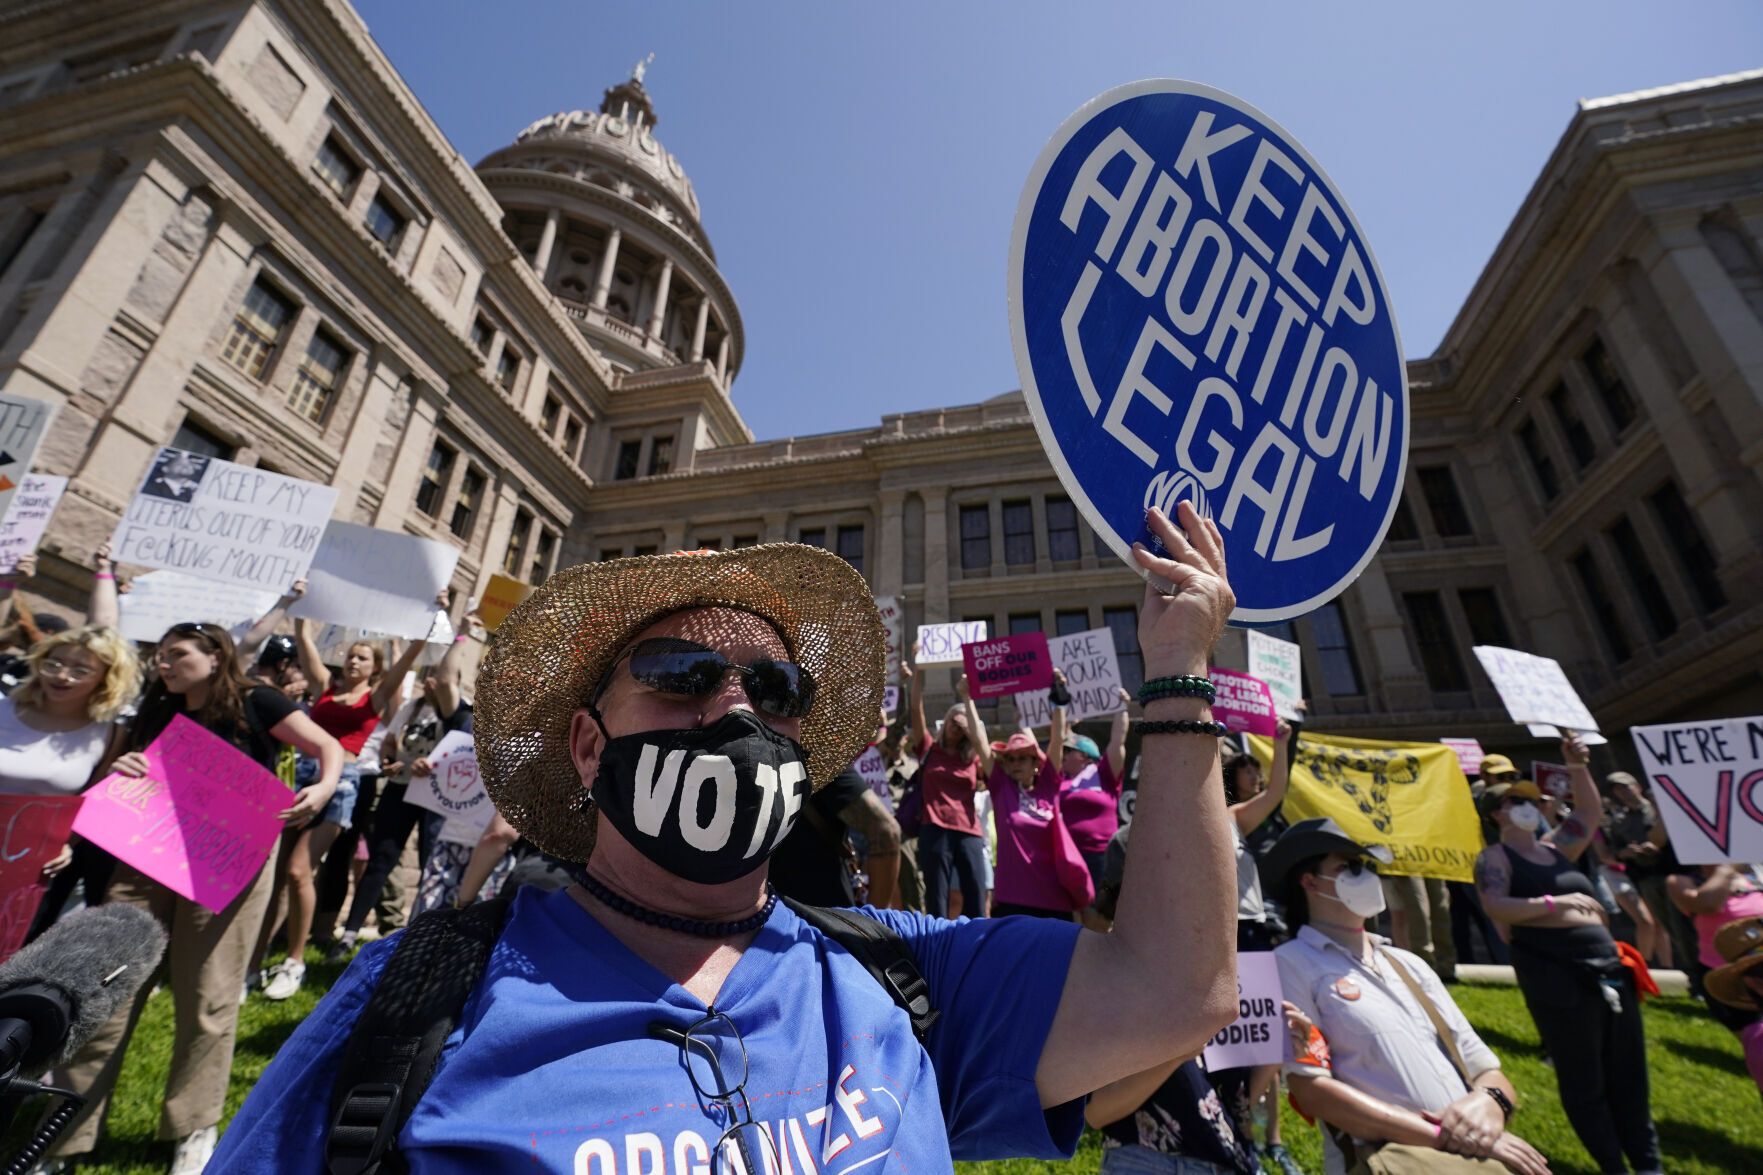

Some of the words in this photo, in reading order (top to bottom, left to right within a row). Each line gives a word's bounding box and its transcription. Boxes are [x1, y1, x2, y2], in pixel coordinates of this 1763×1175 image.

[1173, 110, 1376, 327] KEEP
[1060, 127, 1393, 501] ABORTION
[1061, 260, 1335, 562] LEGAL
[205, 466, 266, 504] KEEP
[268, 481, 311, 515] MY
[127, 498, 204, 534] UTERUS
[207, 510, 252, 541] OUT
[251, 514, 276, 545] OF
[280, 521, 321, 553] YOUR
[218, 548, 301, 587] MOUTH
[972, 641, 1011, 658] BANS
[975, 657, 1004, 671] OFF
[1006, 651, 1037, 665] OUR
[1062, 635, 1102, 662] ARE
[978, 664, 1033, 683] BODIES
[1210, 672, 1261, 691] PROTECT
[1021, 684, 1122, 727] HAMAIDS
[1214, 696, 1270, 716] BORTION
[1237, 688, 1271, 706] LEGAL
[1637, 726, 1737, 766] WE'RE
[633, 743, 807, 860] VOTE
[1434, 846, 1460, 866] ON
[1239, 998, 1277, 1019] OUR
[1207, 1023, 1270, 1047] ODIES
